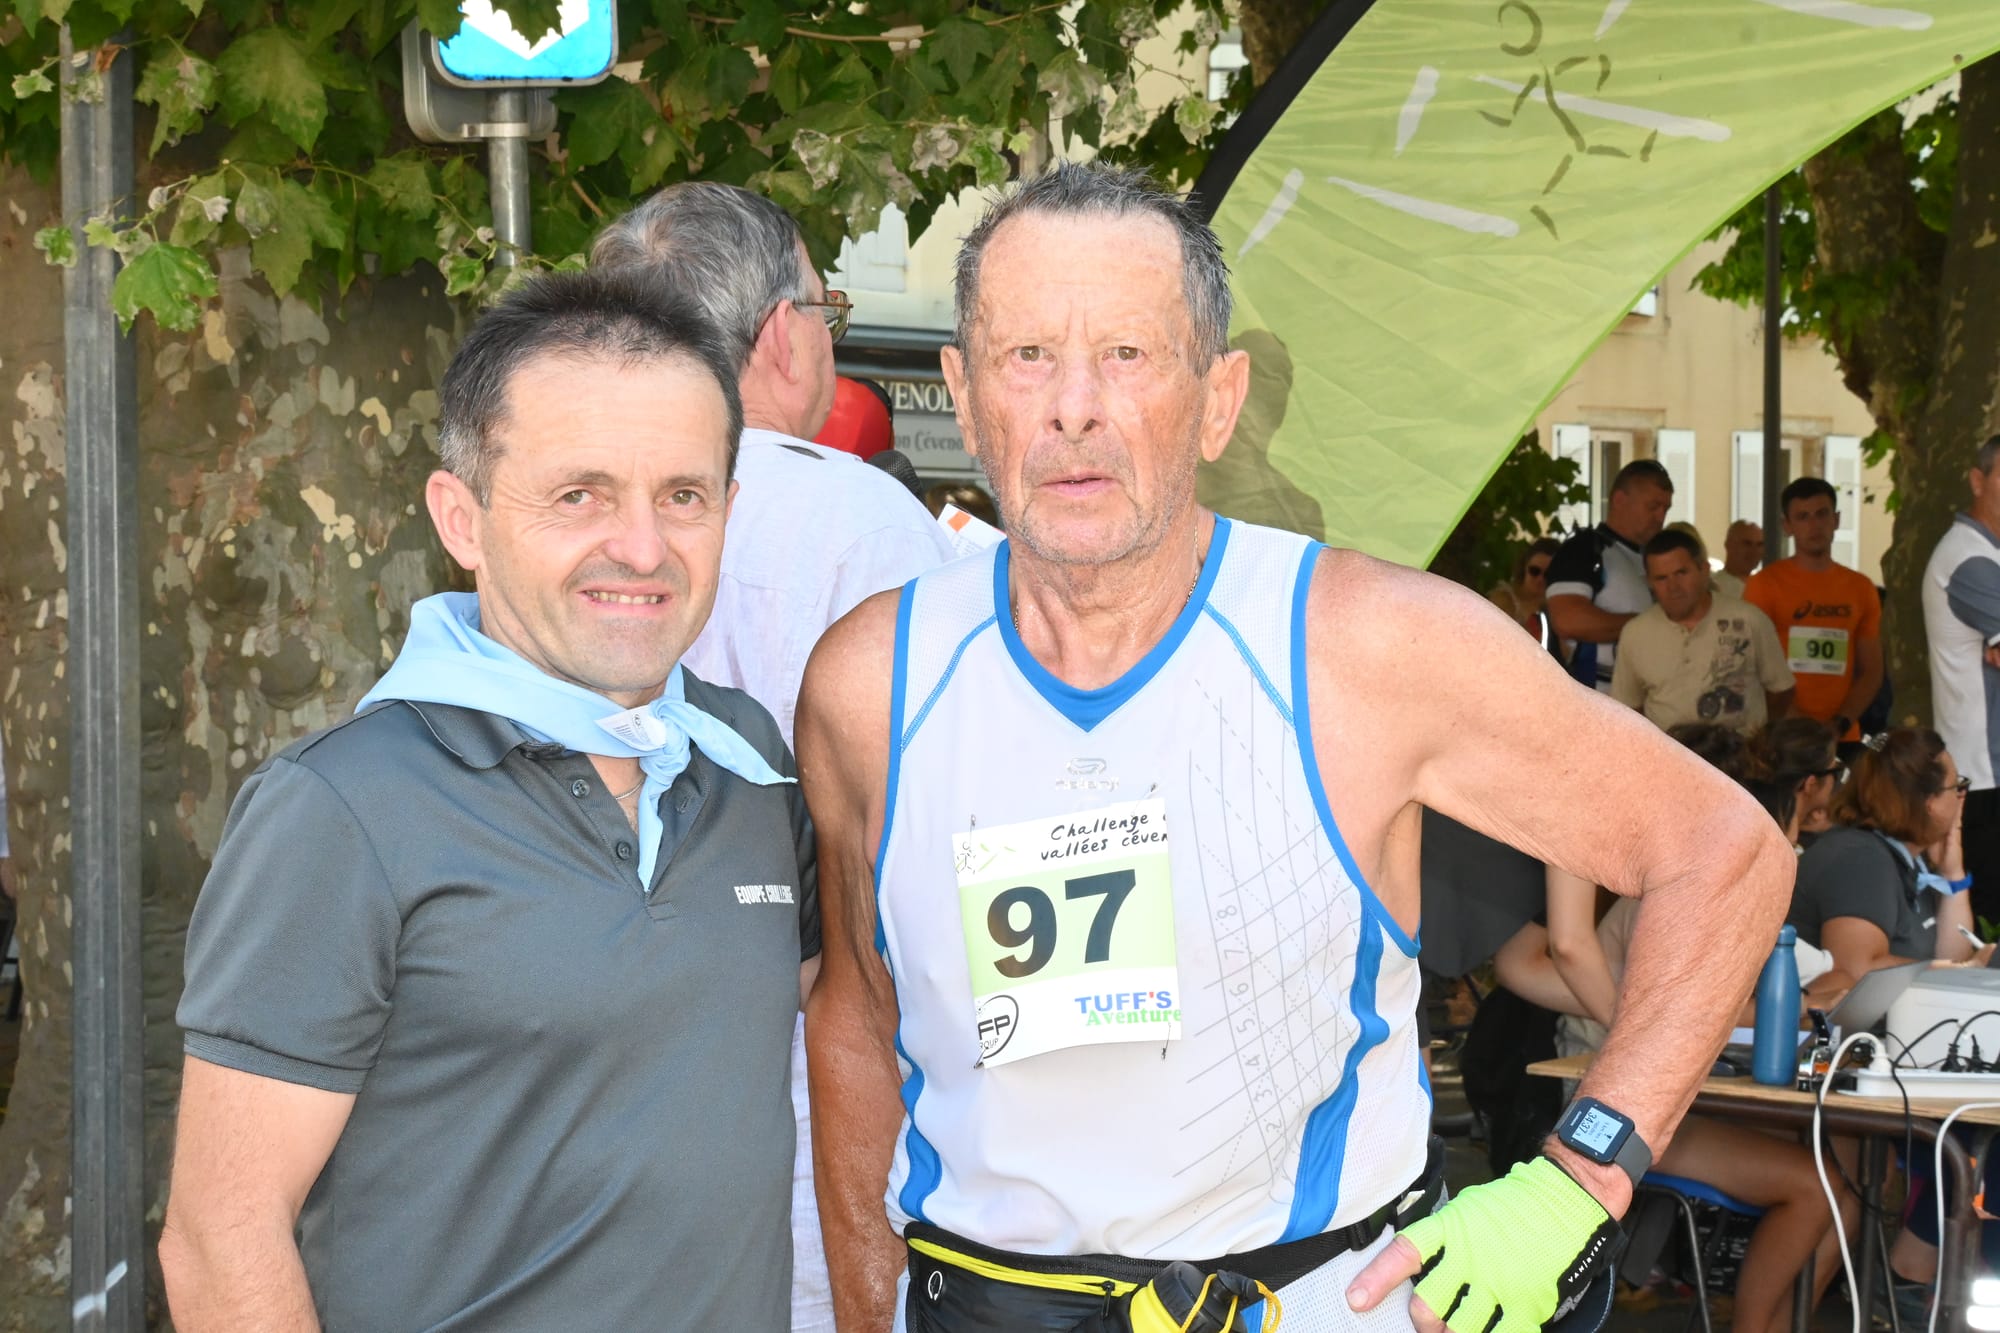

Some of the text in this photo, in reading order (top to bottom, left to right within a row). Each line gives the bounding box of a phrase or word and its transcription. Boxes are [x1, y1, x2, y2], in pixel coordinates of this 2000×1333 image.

[1806, 639, 1834, 660] 90
[1051, 814, 1149, 840] Challenge
[1041, 837, 1109, 860] vallées
[733, 885, 768, 904] EQUIPE
[987, 869, 1136, 978] 97
[1074, 991, 1172, 1014] TUFF'S
[1086, 1008, 1181, 1026] Aventure
